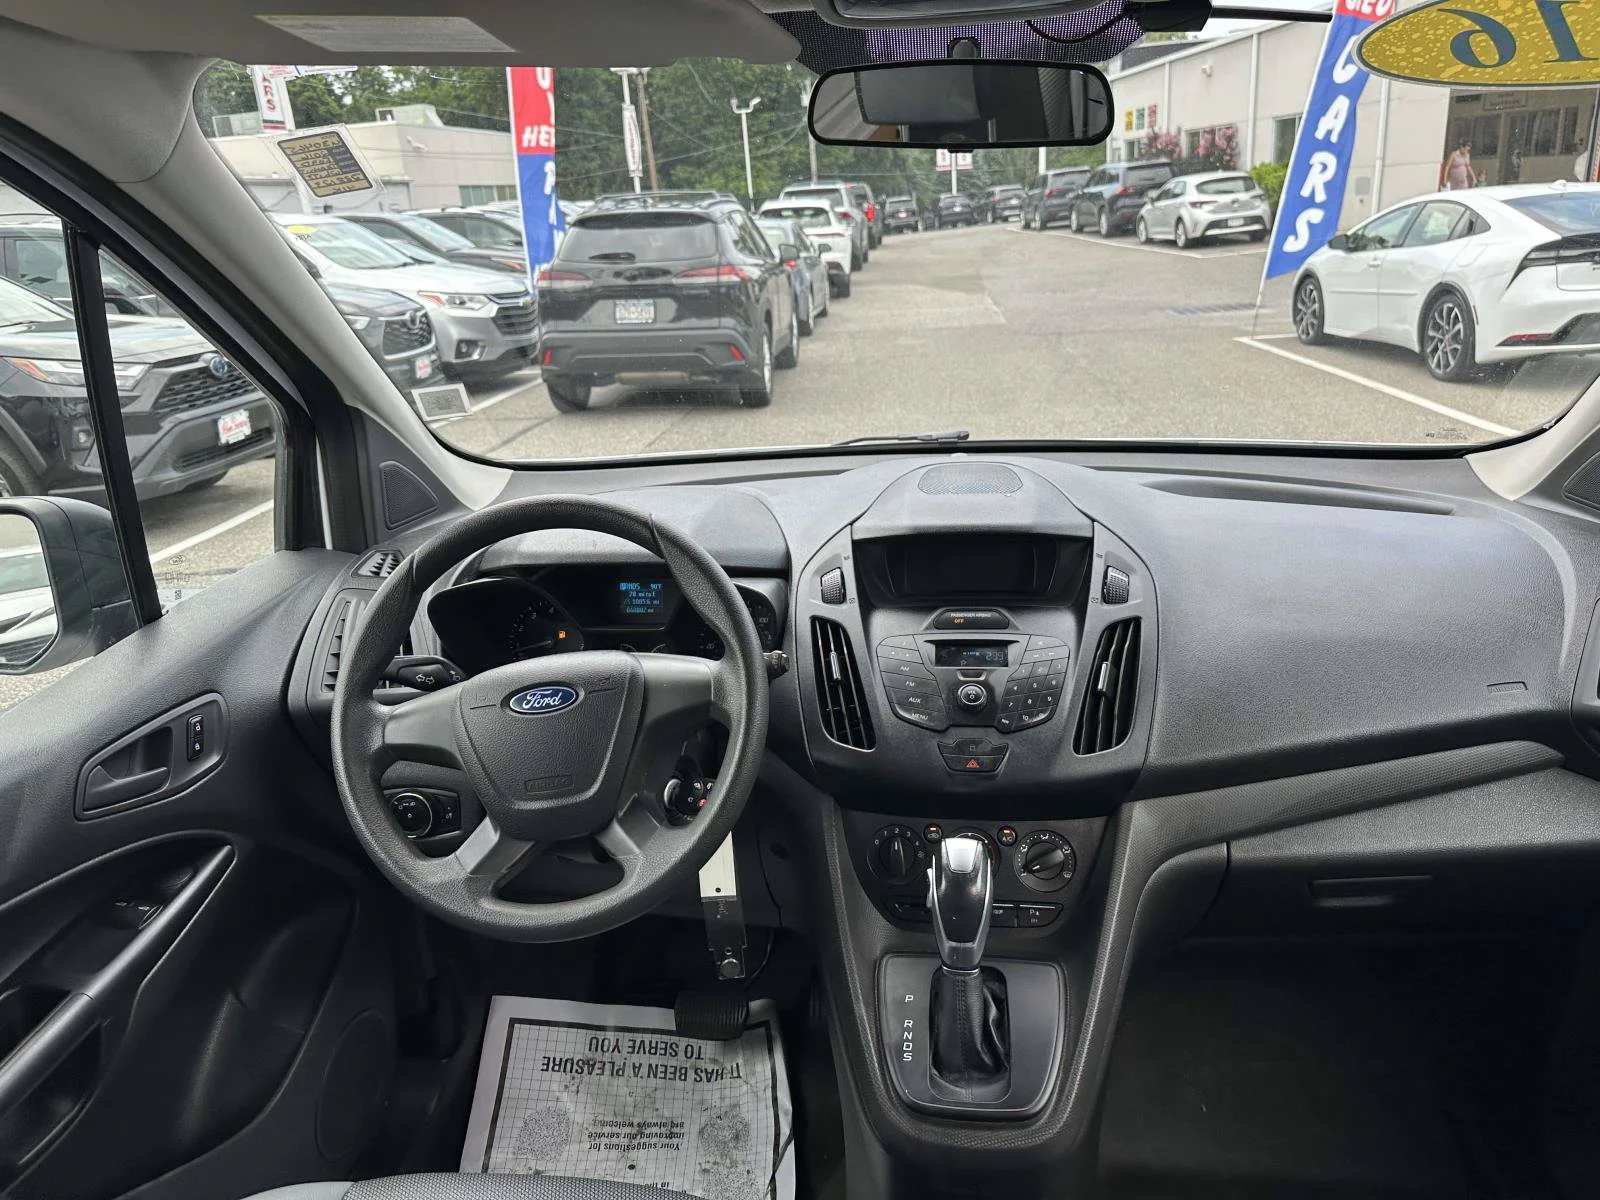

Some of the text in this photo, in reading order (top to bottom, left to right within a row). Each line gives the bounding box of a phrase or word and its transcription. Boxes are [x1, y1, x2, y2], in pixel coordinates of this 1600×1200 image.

[1282, 34, 1358, 252] CARS
[522, 690, 562, 709] Ford
[902, 995, 914, 1061] P R N D S
[588, 1036, 704, 1060] TO SERVE YOU
[540, 1056, 626, 1077] PLEASURE
[632, 1062, 643, 1078] A
[647, 1063, 687, 1082] BEEN
[694, 1066, 724, 1083] HAS
[637, 1120, 668, 1129] always
[588, 1131, 684, 1140] improving our service
[604, 1141, 657, 1152] suggestions
[660, 1143, 680, 1151] Your
